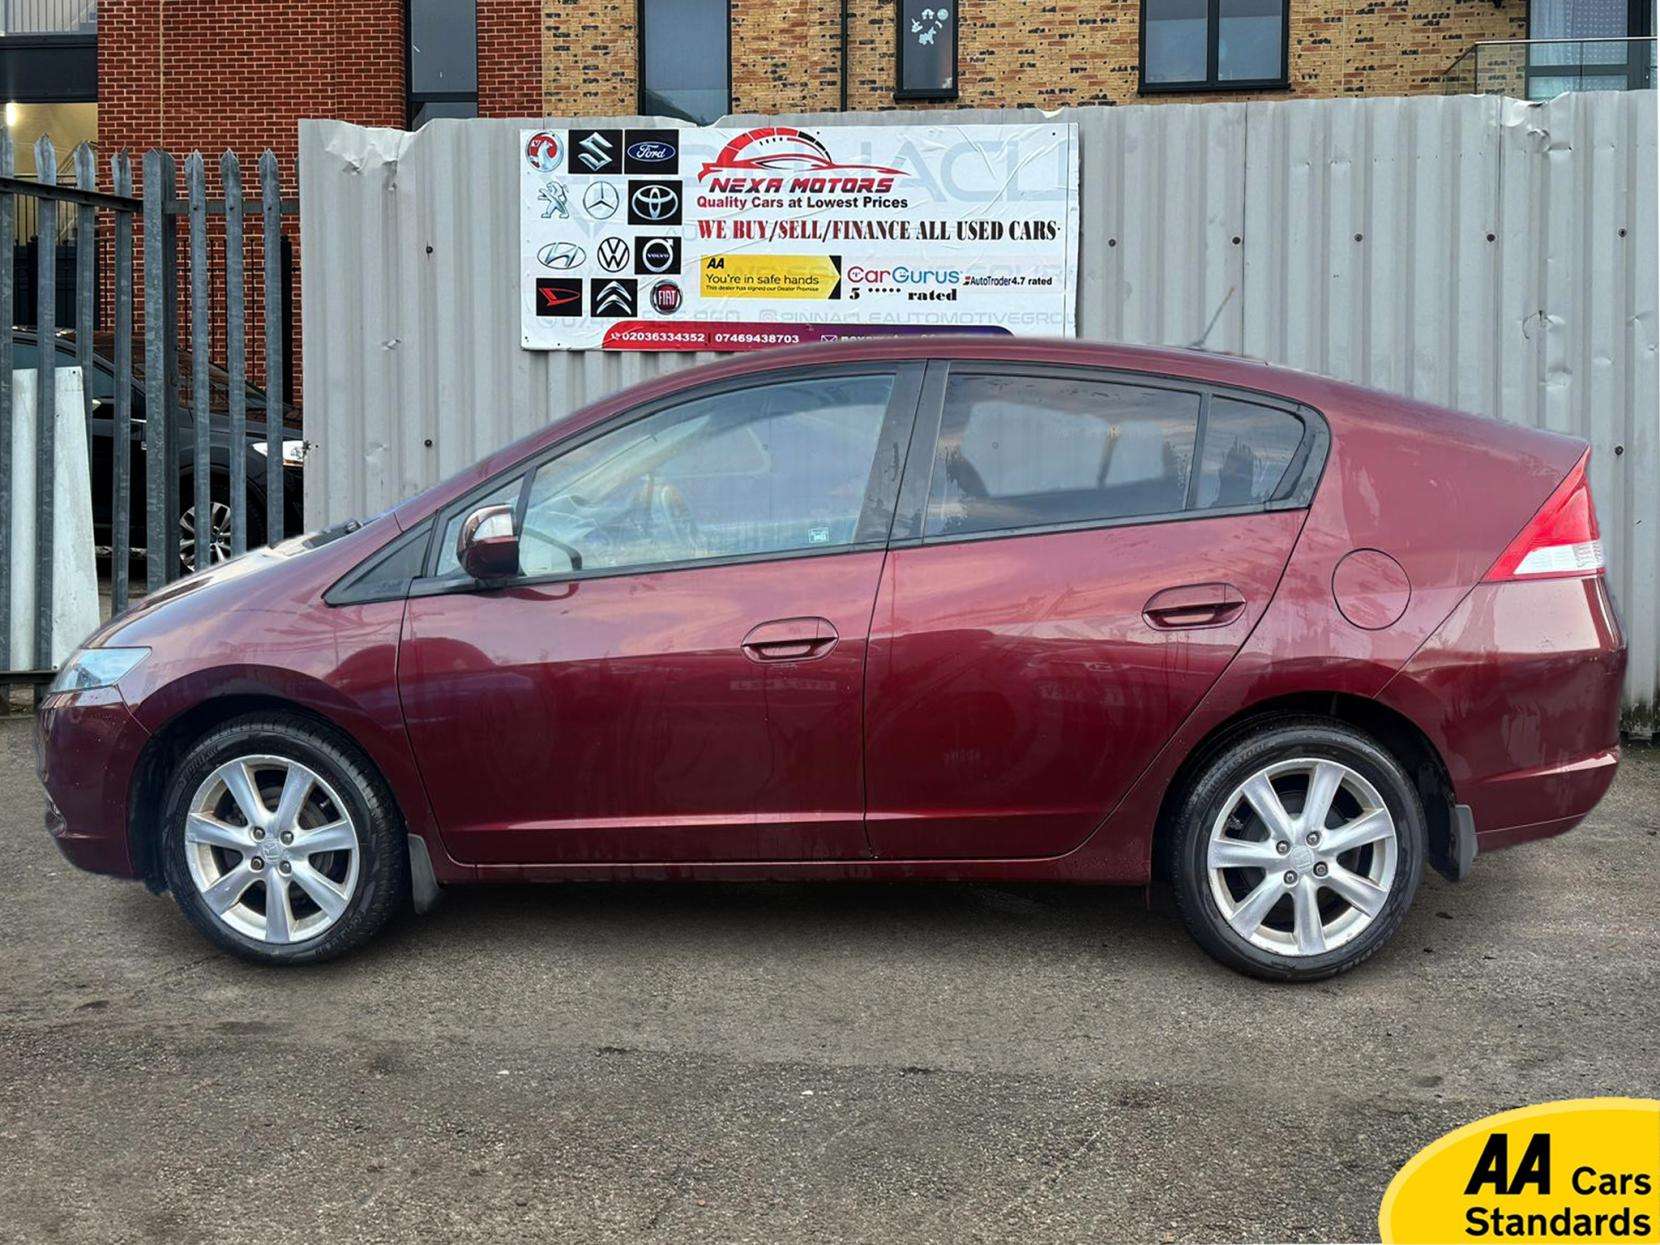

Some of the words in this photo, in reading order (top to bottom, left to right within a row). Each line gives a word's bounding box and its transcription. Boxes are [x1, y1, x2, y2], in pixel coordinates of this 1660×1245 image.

[636, 143, 666, 159] Ford
[708, 177, 784, 194] NEXA
[789, 177, 894, 194] MOTORS
[697, 195, 749, 211] Quality
[752, 196, 784, 209] Cars
[788, 197, 803, 209] at
[807, 196, 859, 209] Lowest
[863, 196, 908, 209] Prices
[698, 219, 727, 240] WE
[915, 220, 951, 240] ALL
[956, 220, 1004, 240] USED
[1008, 220, 1057, 241] CARS
[707, 257, 725, 269] AA
[706, 273, 741, 285] You're
[744, 274, 754, 284] in
[757, 274, 781, 285] safe
[784, 275, 820, 285] hands
[847, 265, 960, 284] CarGurus
[1028, 276, 1053, 286] rated
[658, 289, 677, 306] FIAT
[849, 287, 860, 301] 5
[908, 288, 957, 301] rated
[622, 332, 706, 343] 02036334352
[714, 333, 800, 344] 07469438703
